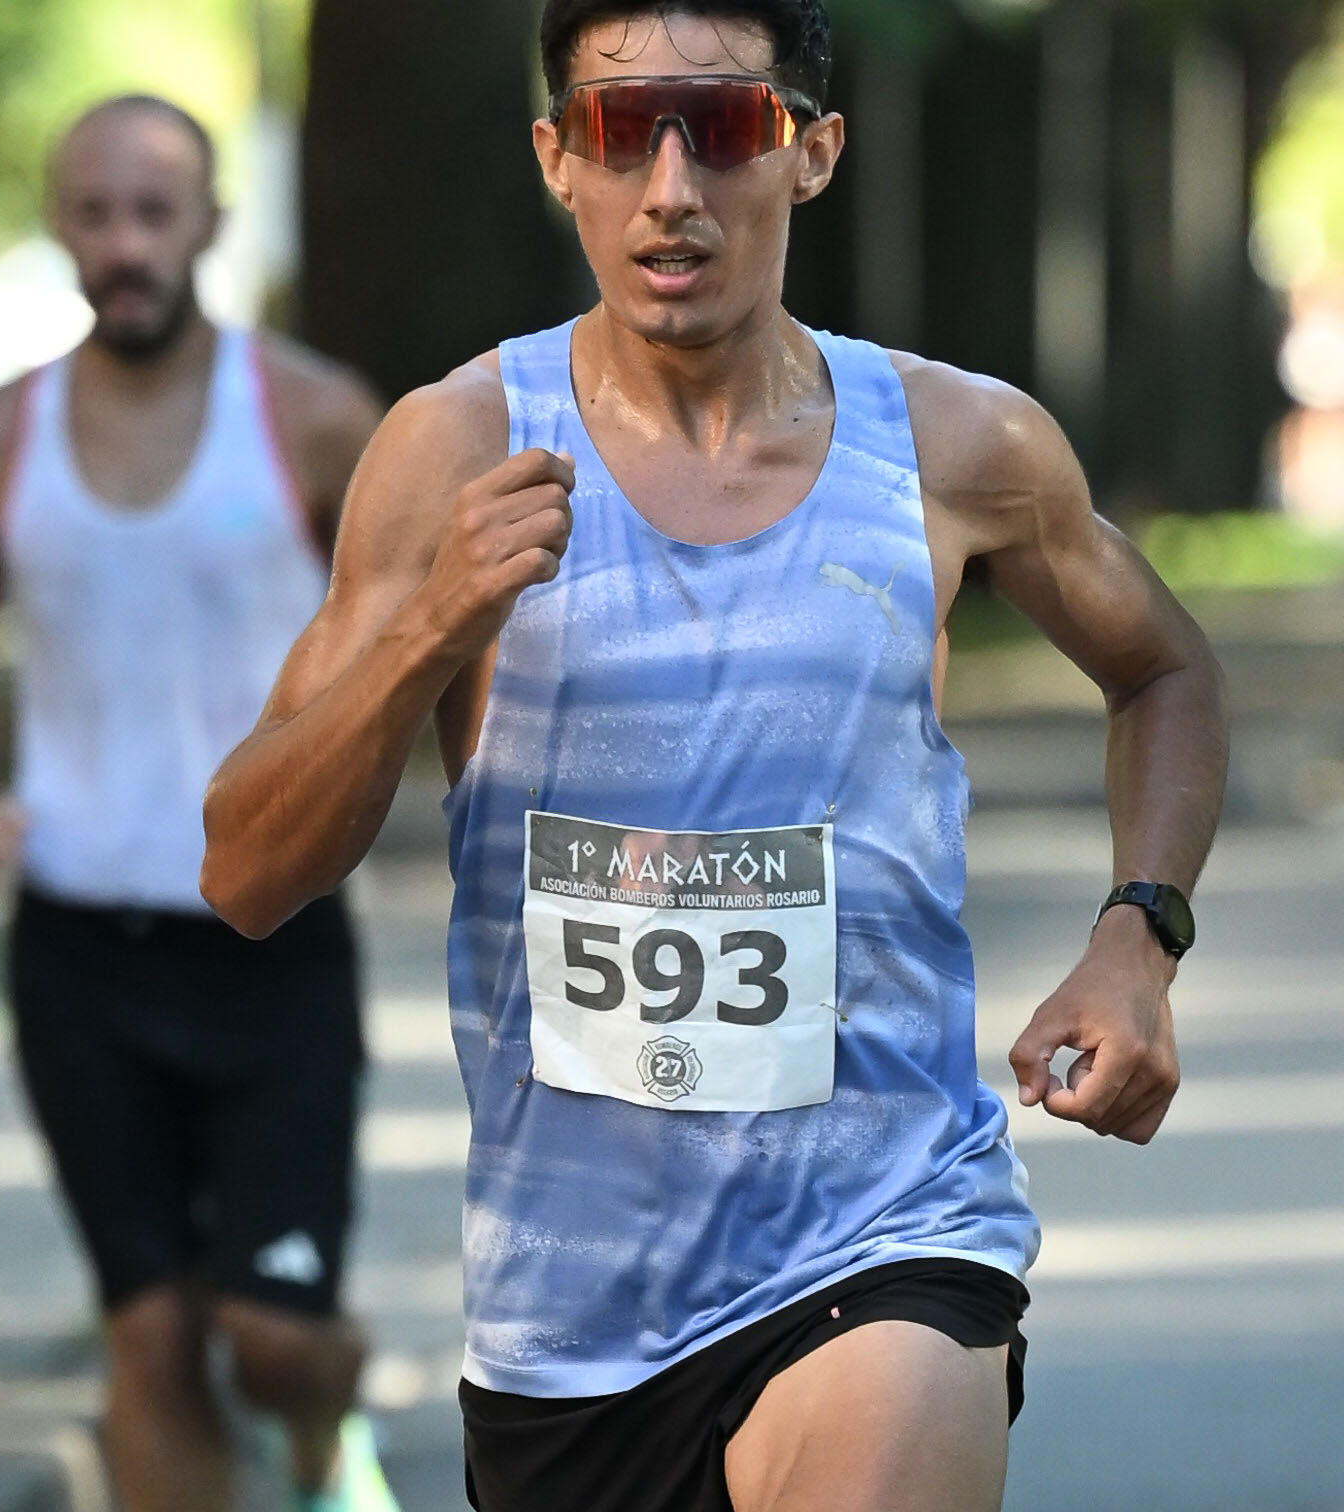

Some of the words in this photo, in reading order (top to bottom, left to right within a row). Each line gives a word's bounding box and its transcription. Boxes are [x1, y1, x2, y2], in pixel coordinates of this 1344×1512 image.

[606, 840, 786, 886] MARATÓN
[540, 876, 607, 900] ASOCIACIÓN
[609, 887, 676, 907] BOMBEROS
[678, 893, 763, 908] VOLUNTARIOS
[766, 889, 820, 907] ROSARIO
[562, 917, 790, 1027] 593
